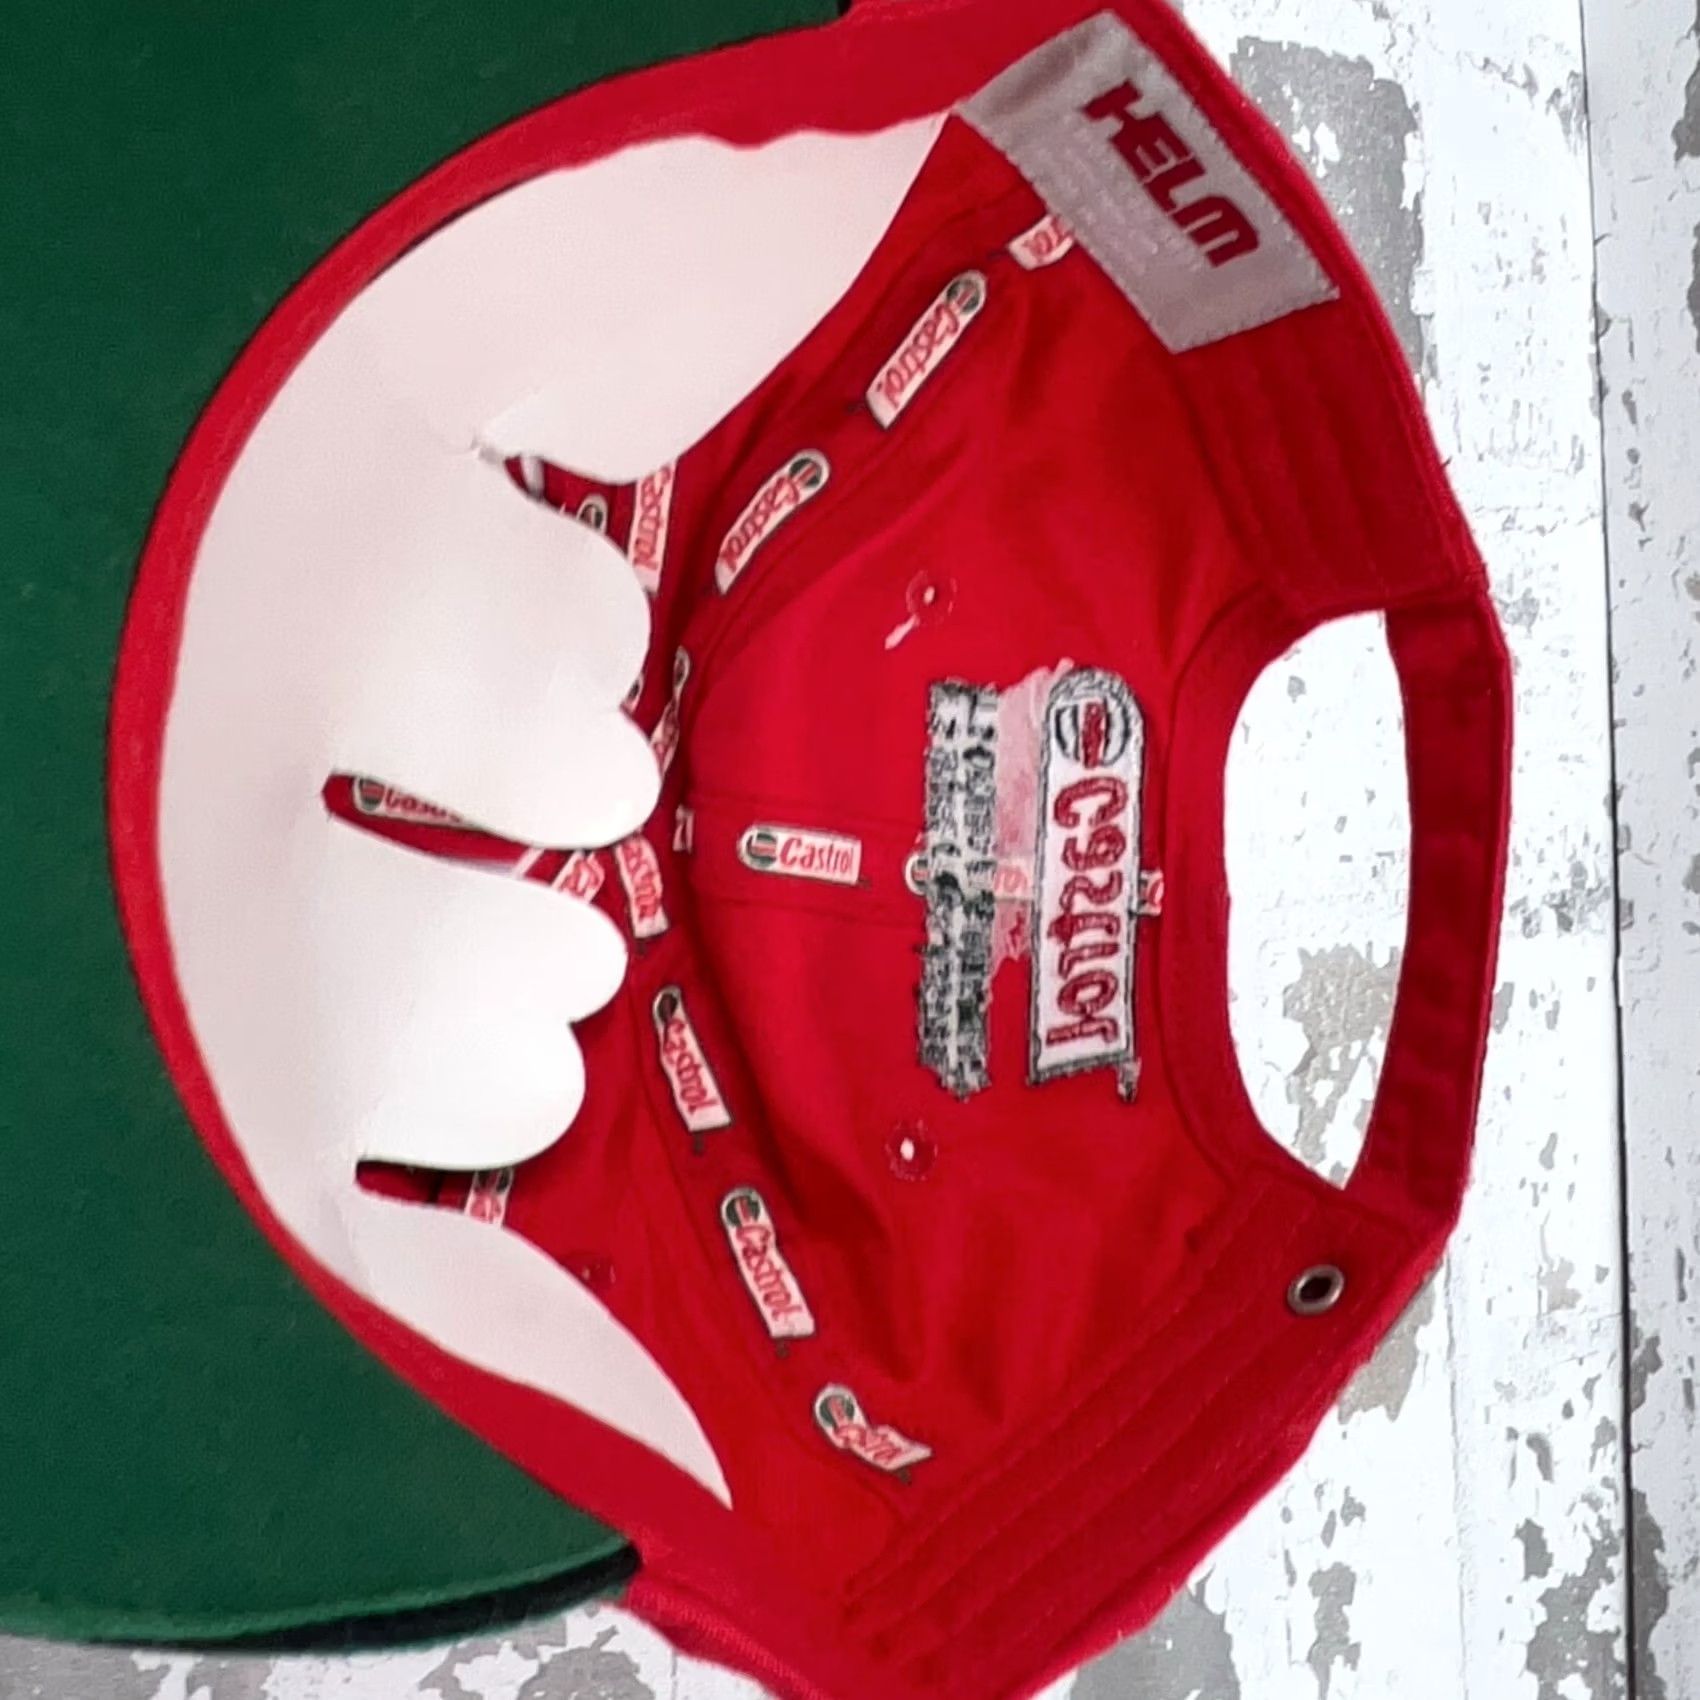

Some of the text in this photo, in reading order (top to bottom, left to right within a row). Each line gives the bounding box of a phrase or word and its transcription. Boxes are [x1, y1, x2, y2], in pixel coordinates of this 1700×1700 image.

[1081, 80, 1260, 268] HELM
[876, 300, 960, 406] Castrol
[719, 474, 801, 572] Castrol
[778, 829, 856, 872] Castrol
[661, 1018, 717, 1115] Castrol
[736, 1223, 803, 1322] Castrol
